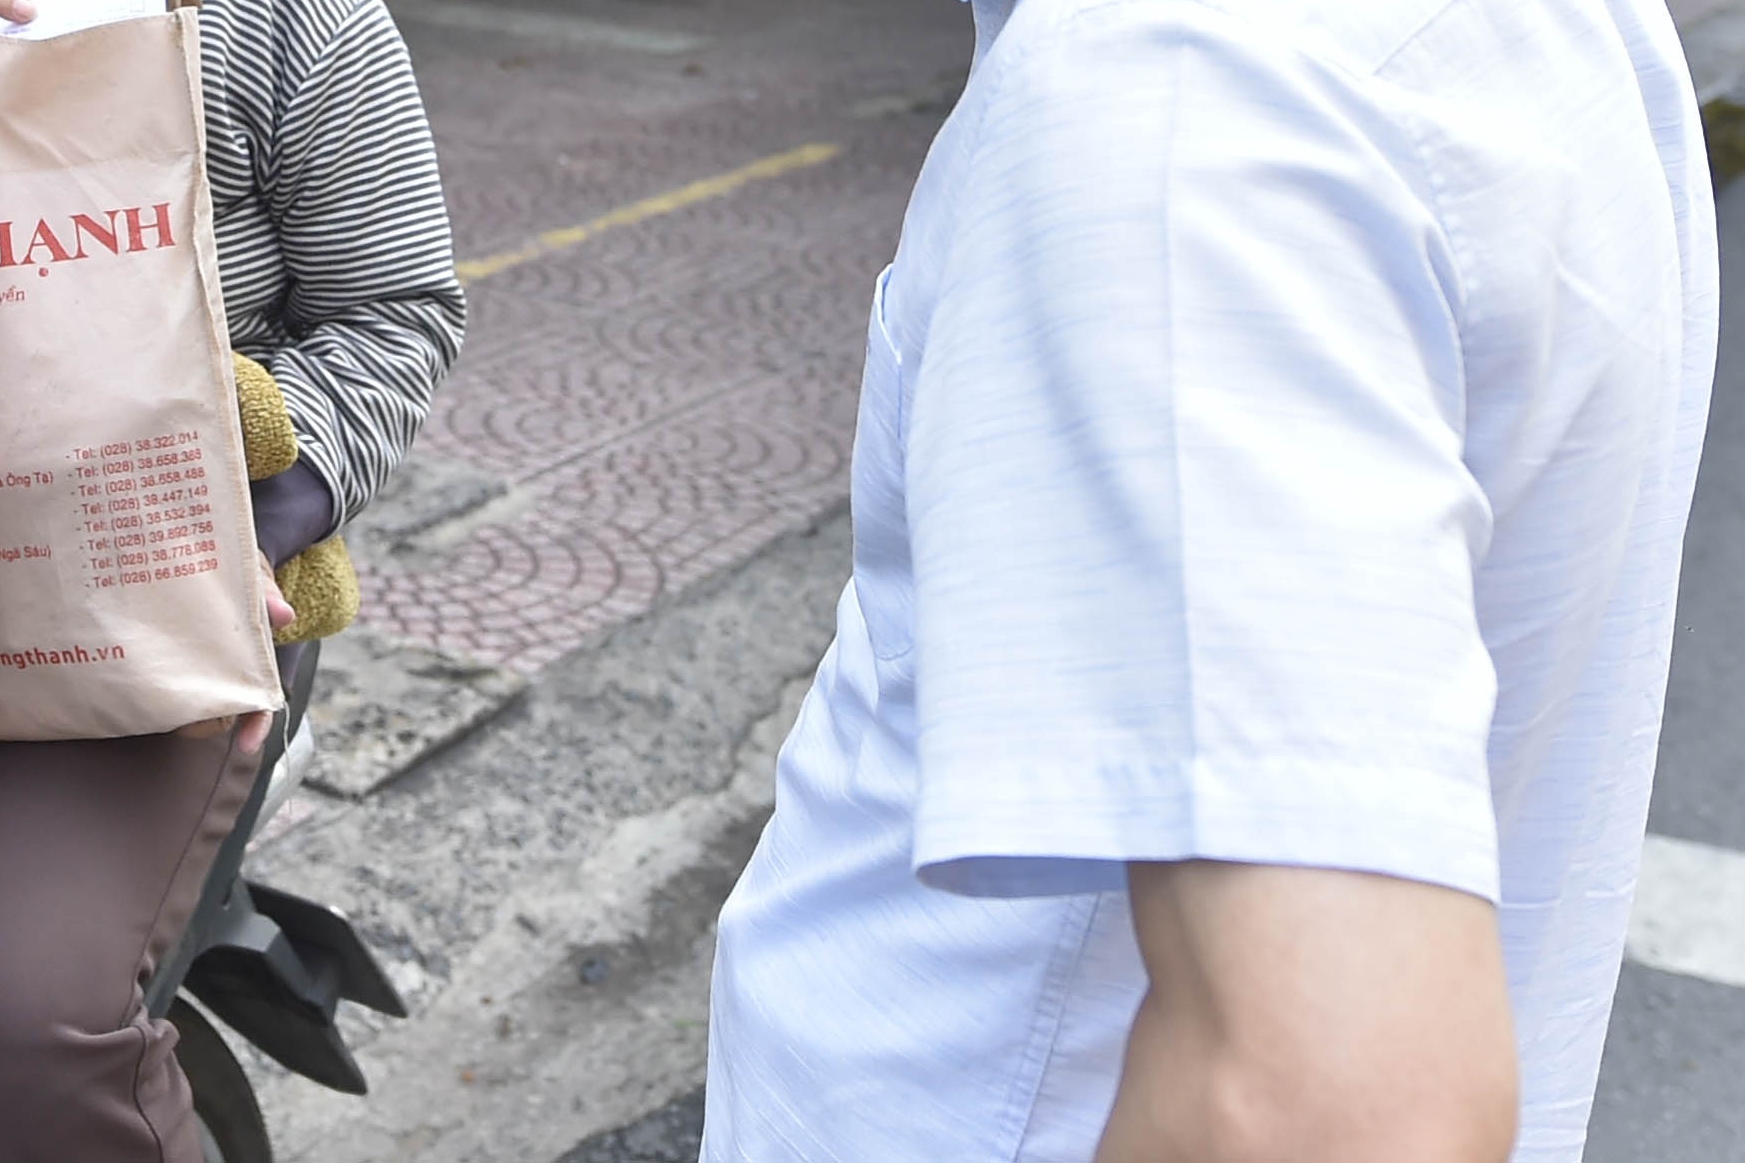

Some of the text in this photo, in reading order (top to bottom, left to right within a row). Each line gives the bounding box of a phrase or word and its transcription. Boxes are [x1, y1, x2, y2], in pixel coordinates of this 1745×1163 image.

[100, 442, 132, 459] (028)
[103, 460, 134, 476] (028)
[106, 478, 137, 495] (028)
[109, 497, 140, 513] (028)
[111, 515, 143, 532] (028)
[114, 533, 146, 549] (028)
[117, 552, 148, 568] (028)
[120, 570, 151, 586] (028)
